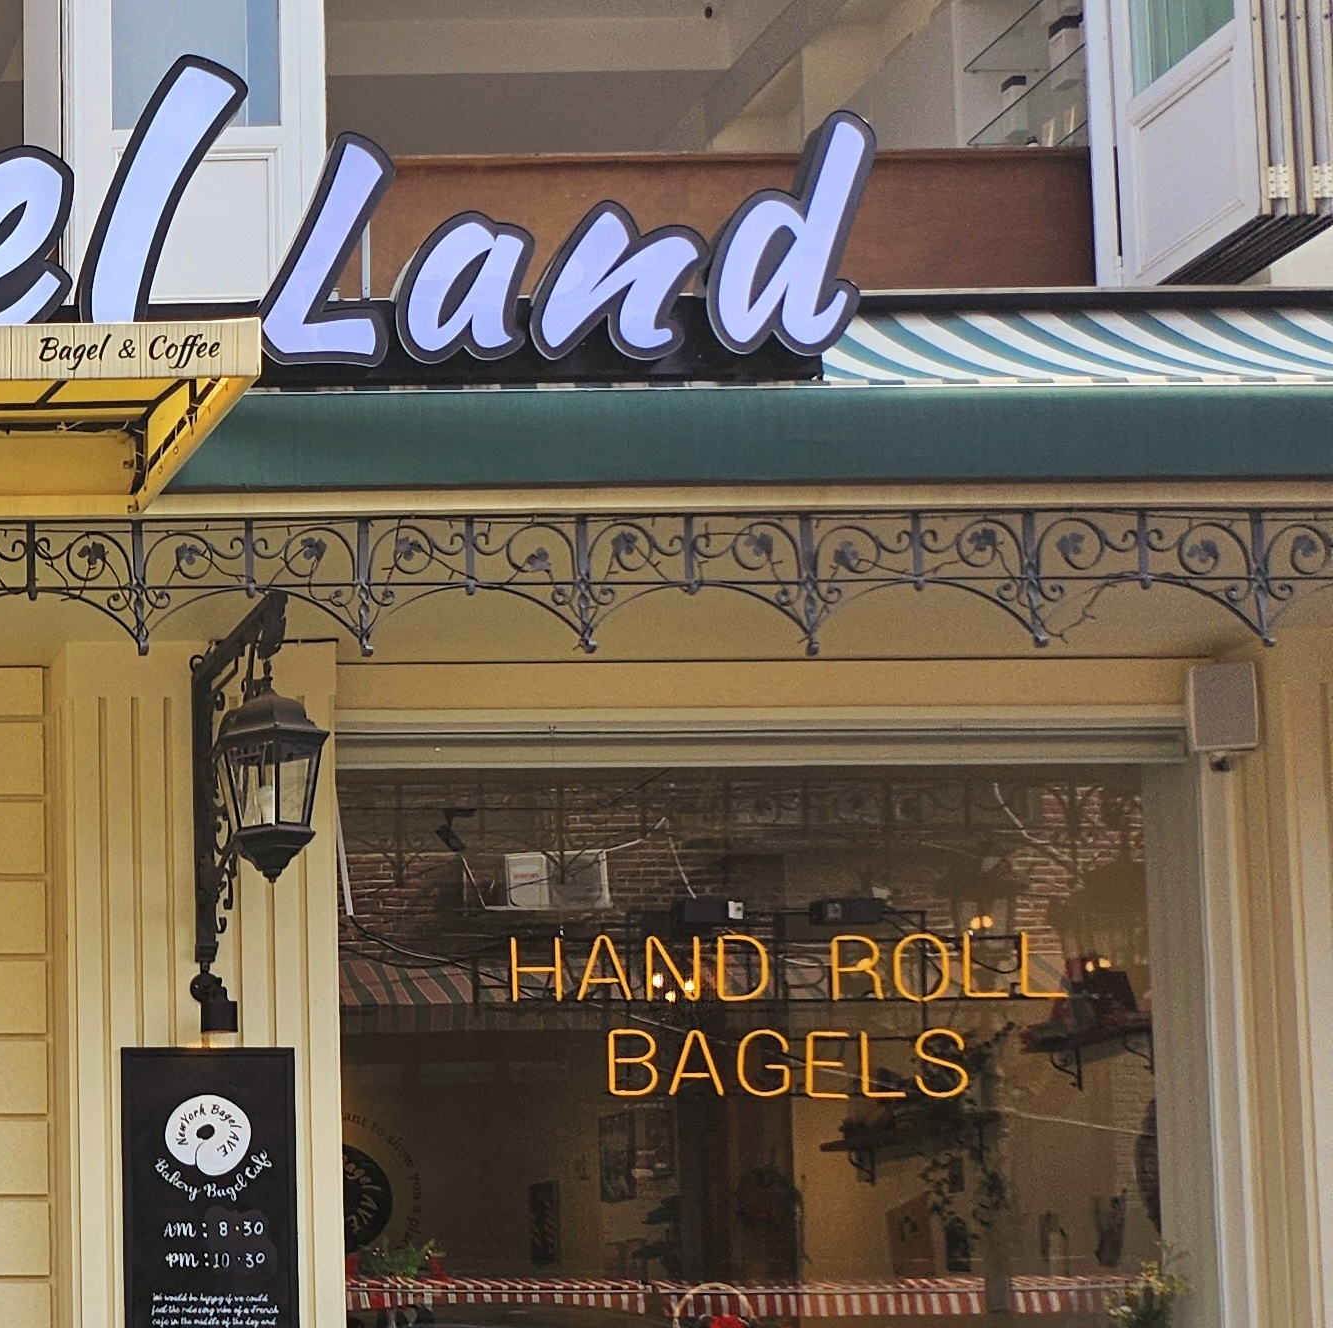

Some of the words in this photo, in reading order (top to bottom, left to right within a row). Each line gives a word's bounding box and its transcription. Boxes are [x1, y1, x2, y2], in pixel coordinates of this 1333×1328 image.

[259, 109, 877, 366] Land
[38, 332, 112, 371] Bagel
[117, 338, 136, 359] &
[147, 333, 221, 369] Coffee
[509, 934, 771, 1004] HAND
[828, 930, 1069, 1001] ROLL
[606, 1028, 971, 1100] BAGELS
[210, 1103, 244, 1130] Bagel
[154, 1157, 202, 1202] Bakery
[203, 1173, 249, 1202] Bagel
[163, 1221, 197, 1238] AM
[165, 1252, 200, 1268] PM
[164, 1292, 188, 1302] would
[200, 1292, 225, 1306] happy
[245, 1293, 269, 1302] could
[193, 1316, 220, 1326] middle
[260, 1316, 277, 1326] and
